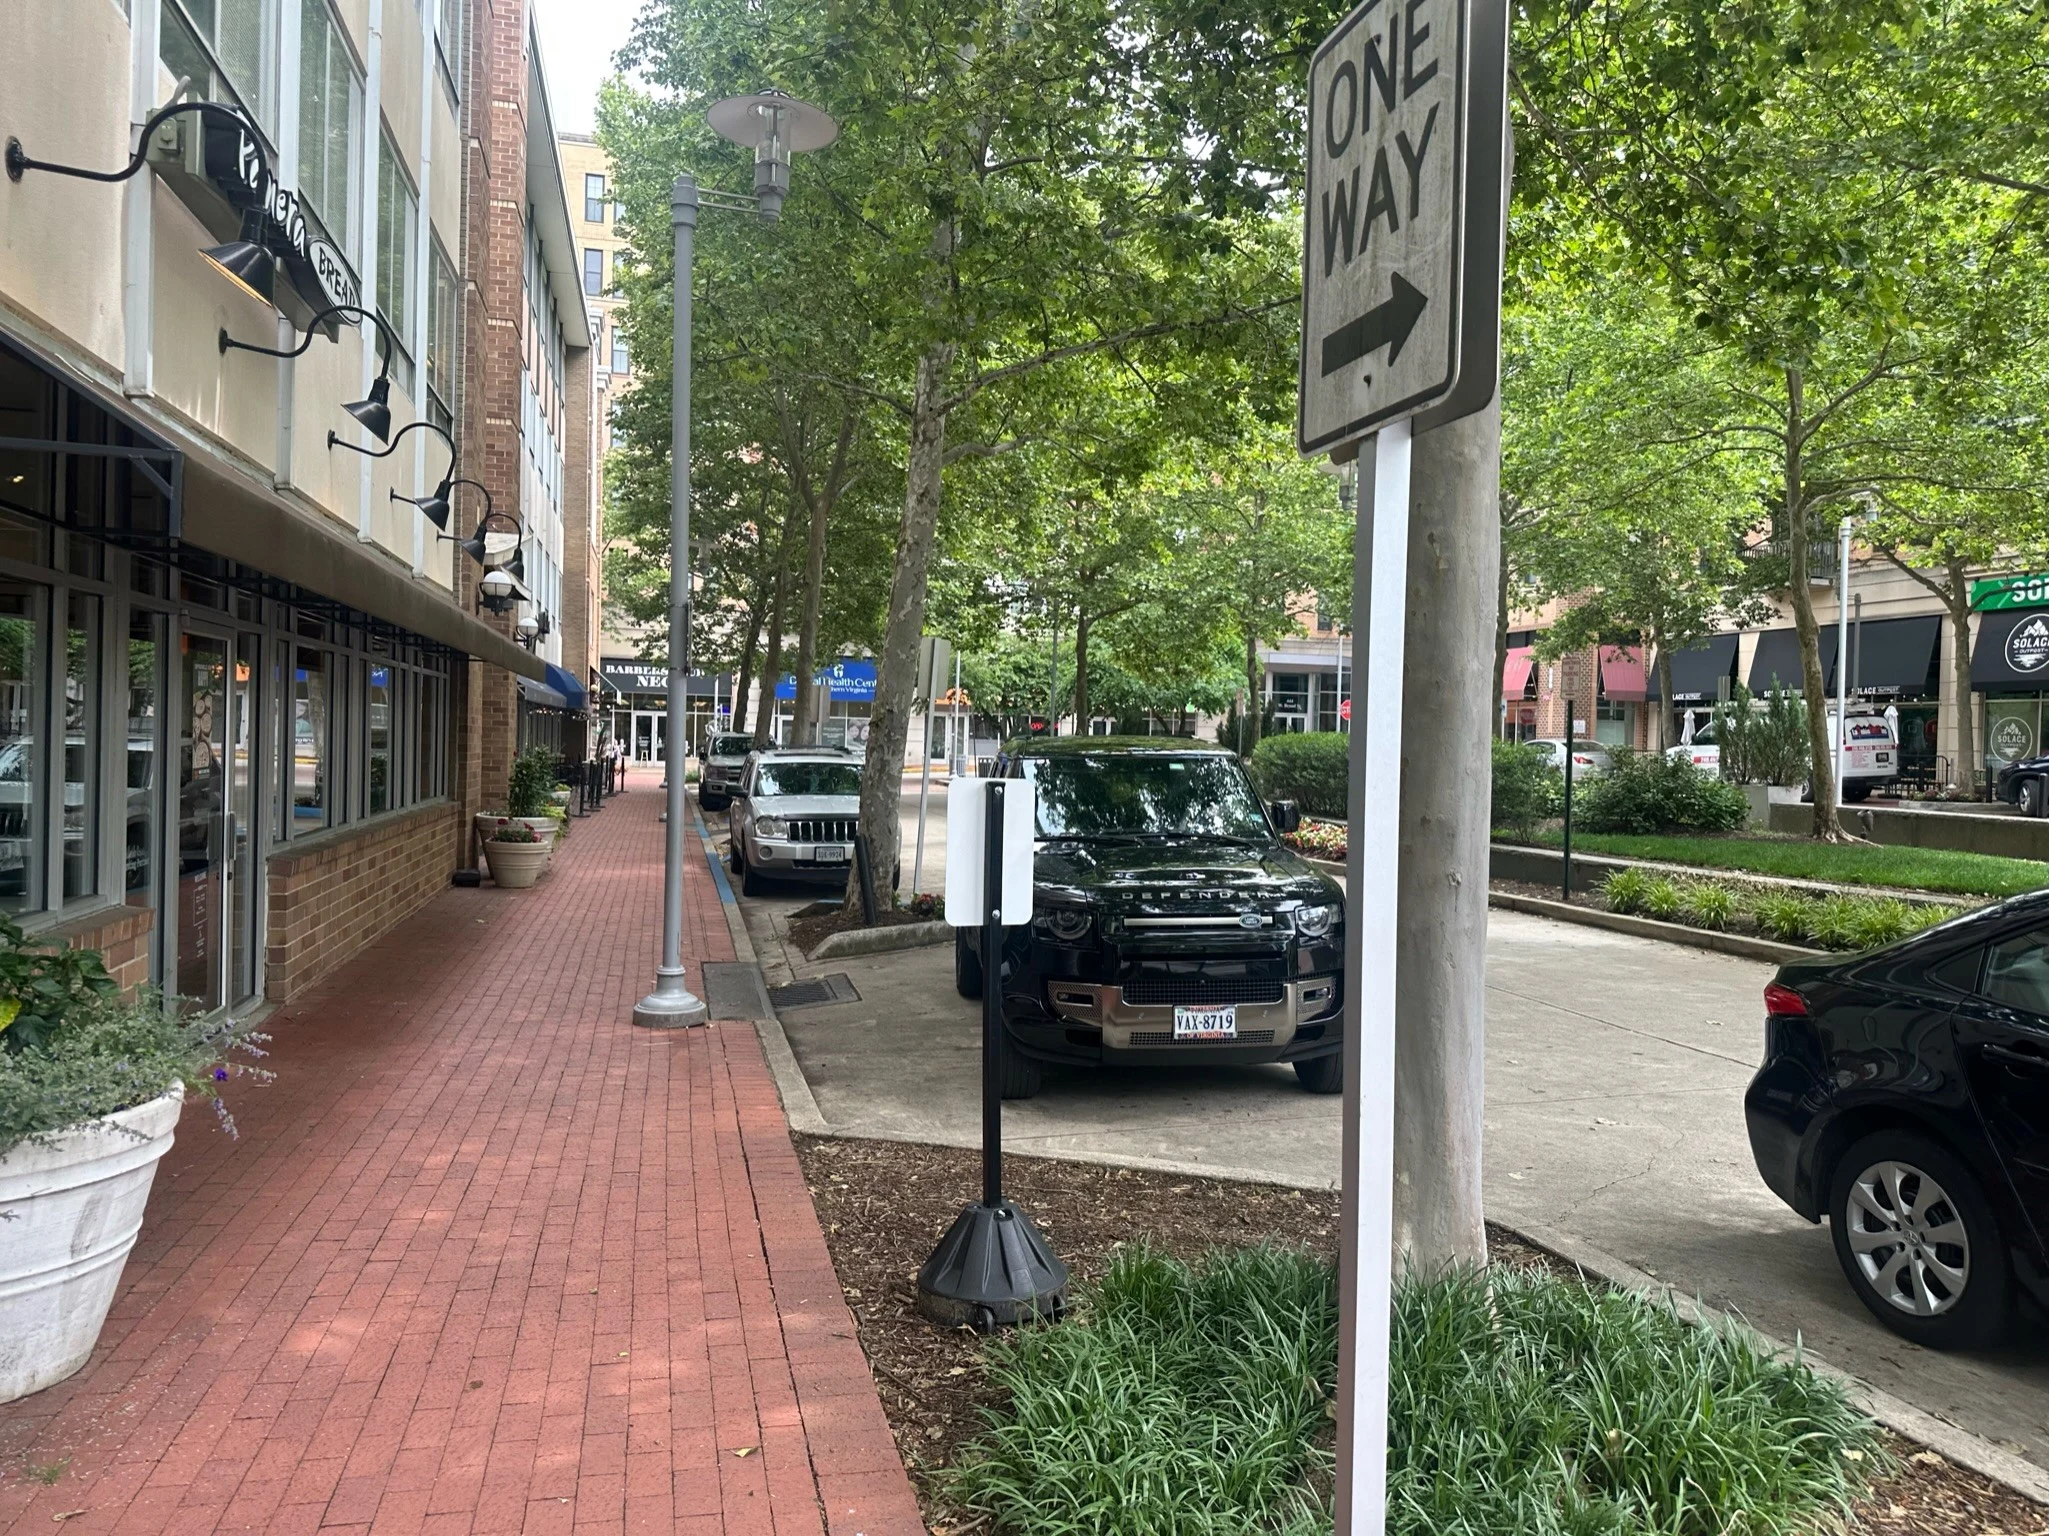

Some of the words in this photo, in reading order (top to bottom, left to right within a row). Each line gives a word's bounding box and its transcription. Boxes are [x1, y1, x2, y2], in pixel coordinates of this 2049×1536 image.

[1326, 0, 1439, 159] ONE
[1321, 102, 1440, 279] WAY
[318, 246, 356, 306] BREAD
[2013, 637, 2049, 649] SOLAC
[1997, 734, 2027, 744] SOLACE
[1122, 892, 1271, 900] DEFENDER
[1177, 1014, 1234, 1030] VAX-8719
